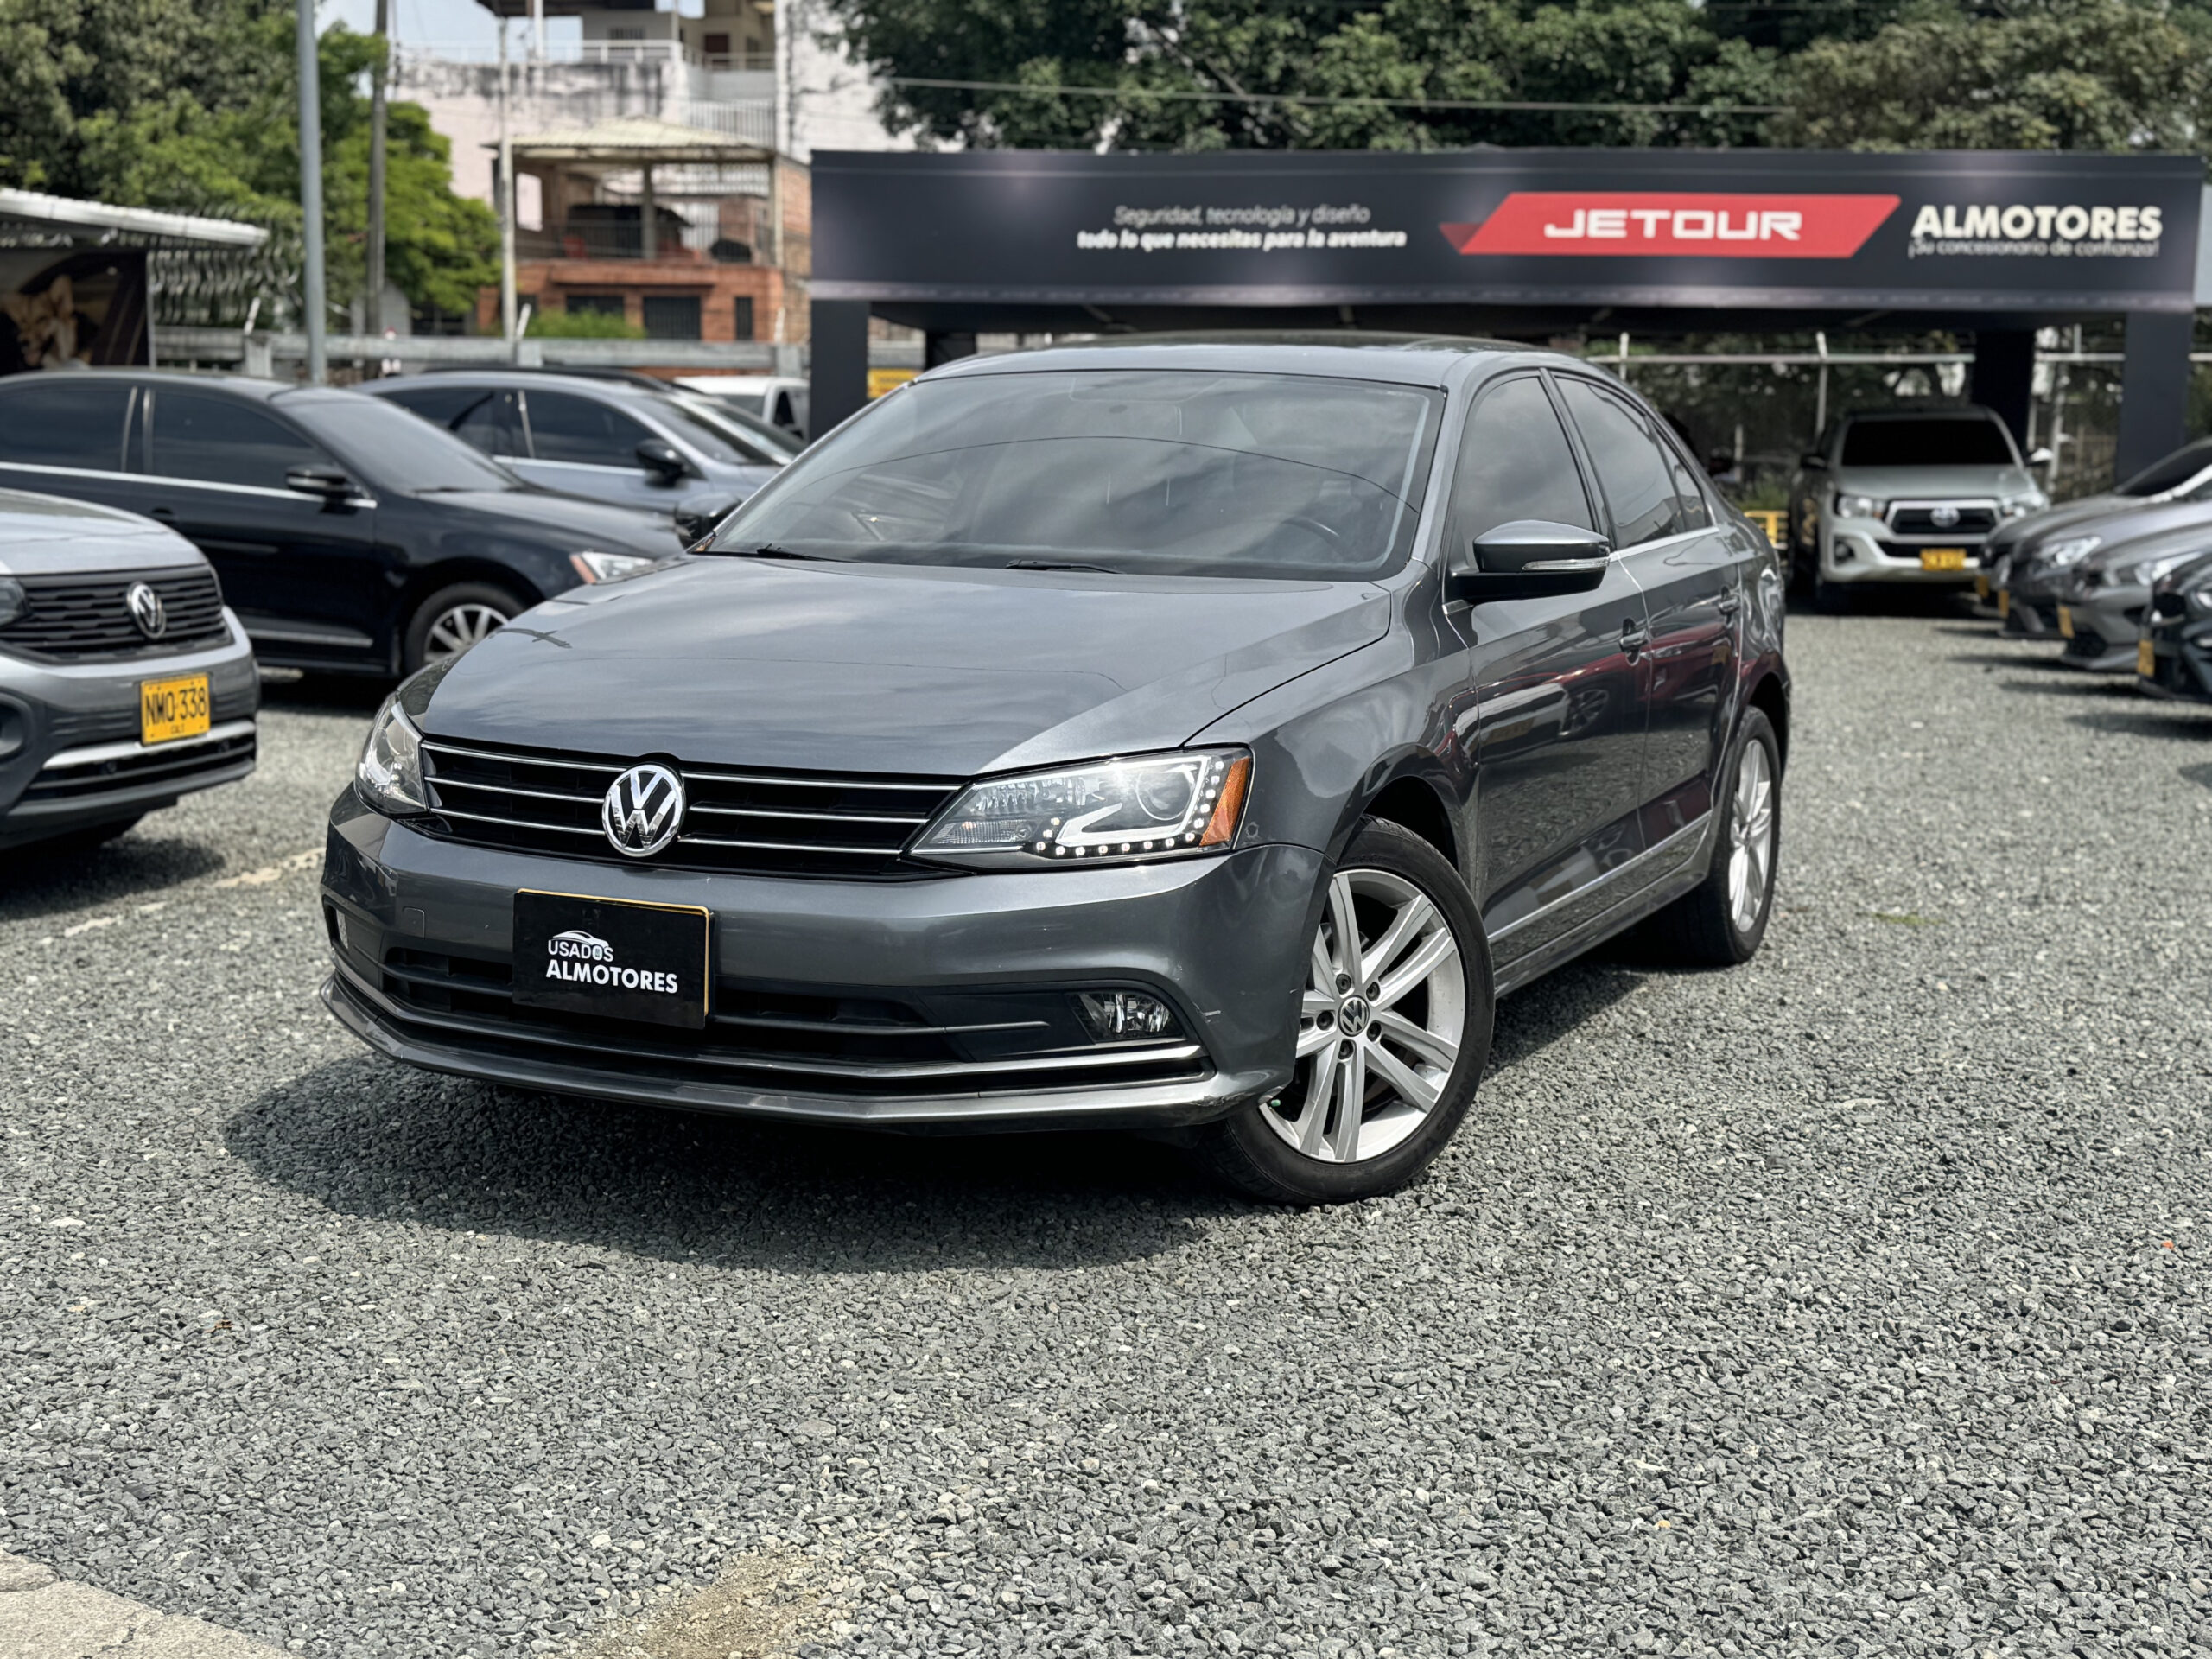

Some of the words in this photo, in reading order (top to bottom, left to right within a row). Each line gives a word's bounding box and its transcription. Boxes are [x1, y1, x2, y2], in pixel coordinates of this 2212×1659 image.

[1297, 209, 1311, 228] y
[1544, 209, 1802, 240] JETOUR
[1910, 204, 2163, 241] ALMOTORES
[1077, 229, 1118, 249] todo
[1120, 229, 1139, 249] lo
[1141, 232, 1175, 252] que
[1177, 228, 1262, 249] necesitas
[1263, 232, 1306, 252] para
[1307, 228, 1326, 248] la
[1327, 229, 1407, 248] aventura
[2050, 238, 2074, 257] de
[179, 687, 207, 720] 338
[602, 763, 684, 857] VW
[547, 939, 614, 963] USADOS
[545, 959, 679, 994] ALMOTORES
